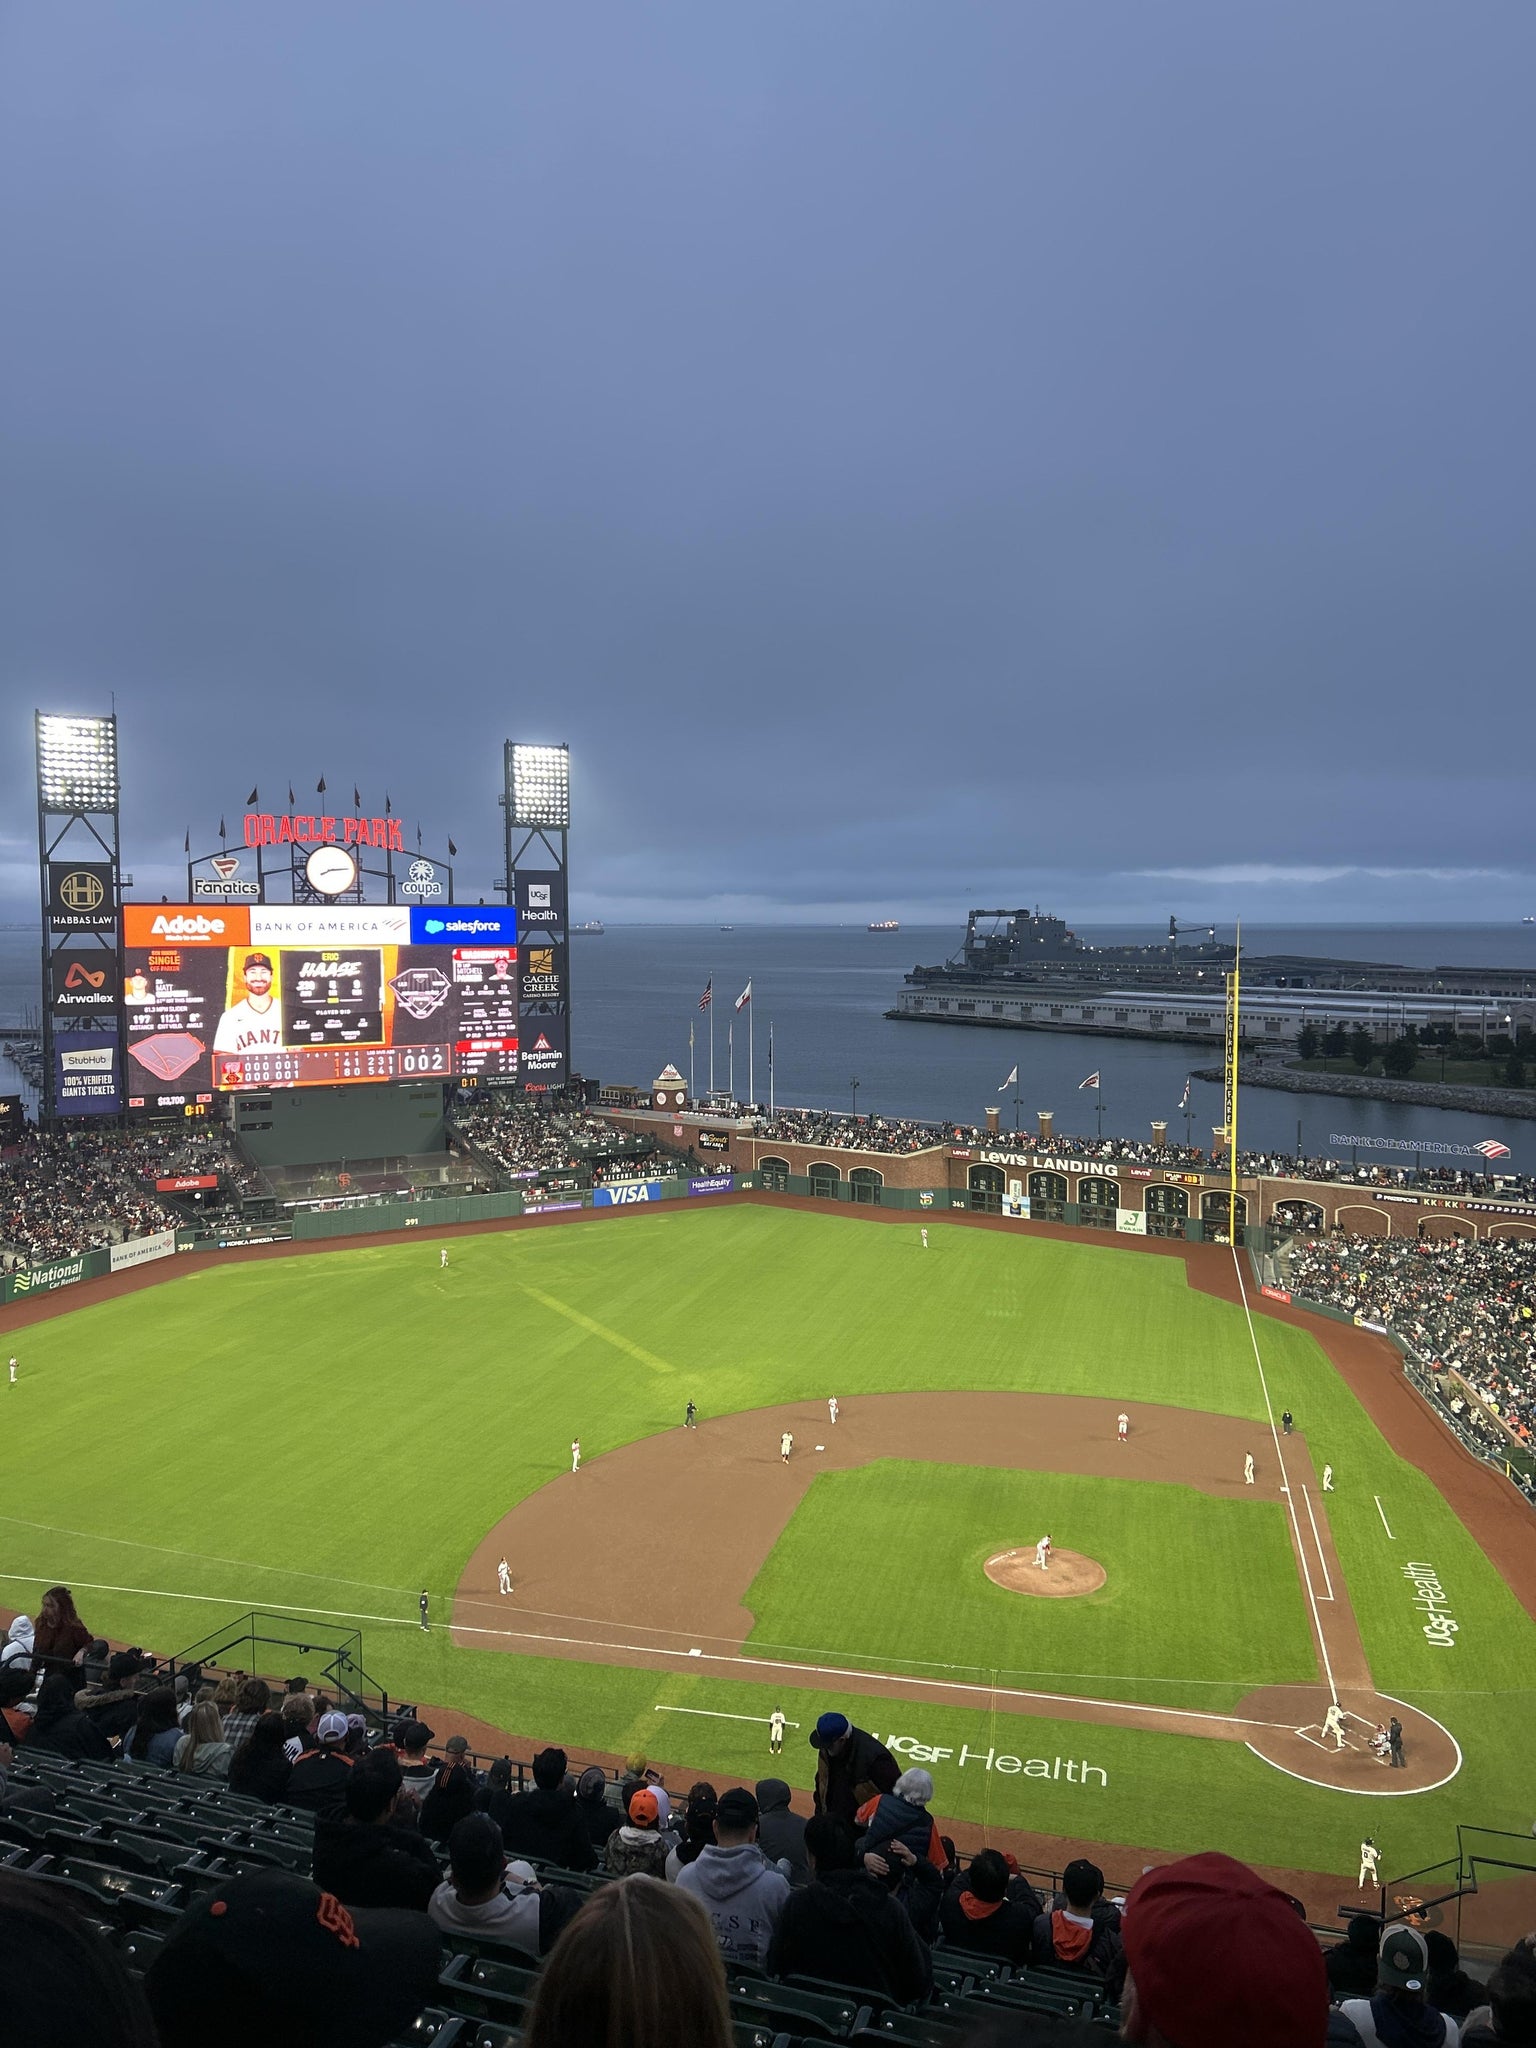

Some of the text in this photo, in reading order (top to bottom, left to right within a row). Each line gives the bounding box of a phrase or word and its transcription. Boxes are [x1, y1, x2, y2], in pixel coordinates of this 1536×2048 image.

[244, 815, 404, 853] ORACLE PARK
[195, 881, 258, 894] Fanatics
[404, 883, 441, 895] coupa
[531, 891, 548, 900] UCSF
[53, 916, 112, 924] HABBAS LAW
[522, 910, 558, 920] Health
[151, 916, 225, 934] Adobe
[256, 922, 378, 931] BANK OF AMERICA
[446, 920, 500, 934] salesforce
[149, 956, 181, 966] SINGLE
[322, 953, 339, 961] ERIC
[299, 962, 362, 978] HAASE
[57, 993, 114, 1004] Airwallex
[133, 1015, 151, 1024] 197
[160, 1014, 180, 1023] 112.1
[68, 1056, 107, 1065] StubHub
[522, 1051, 562, 1062] Benjamin
[528, 1060, 557, 1070] Moore
[64, 1075, 113, 1087] 100% VERIFIED
[62, 1086, 115, 1097] GIANTS TICKETS
[525, 1083, 547, 1092] Coors
[1330, 1134, 1472, 1155] BANK OF AMERICA
[1033, 1157, 1118, 1177] LANDING
[339, 1173, 350, 1188] SF
[603, 1173, 632, 1181] WELCOME
[175, 1179, 200, 1188] Adobe
[692, 1179, 731, 1189] HealthEquity
[606, 1185, 649, 1204] VISA
[952, 1200, 964, 1208] 365
[405, 1218, 419, 1226] 391
[227, 1239, 249, 1247] KONICA
[250, 1237, 273, 1245] MINOLTA
[1214, 1234, 1230, 1244] 309
[178, 1243, 194, 1252] 399
[112, 1244, 162, 1264] BANK OF AMERICA
[32, 1259, 83, 1286] National
[49, 1274, 81, 1290] Car Rental
[1265, 1289, 1287, 1301] ORACLE
[1400, 1562, 1459, 1647] UCSF Health
[872, 1732, 1108, 1787] UCSF Health
